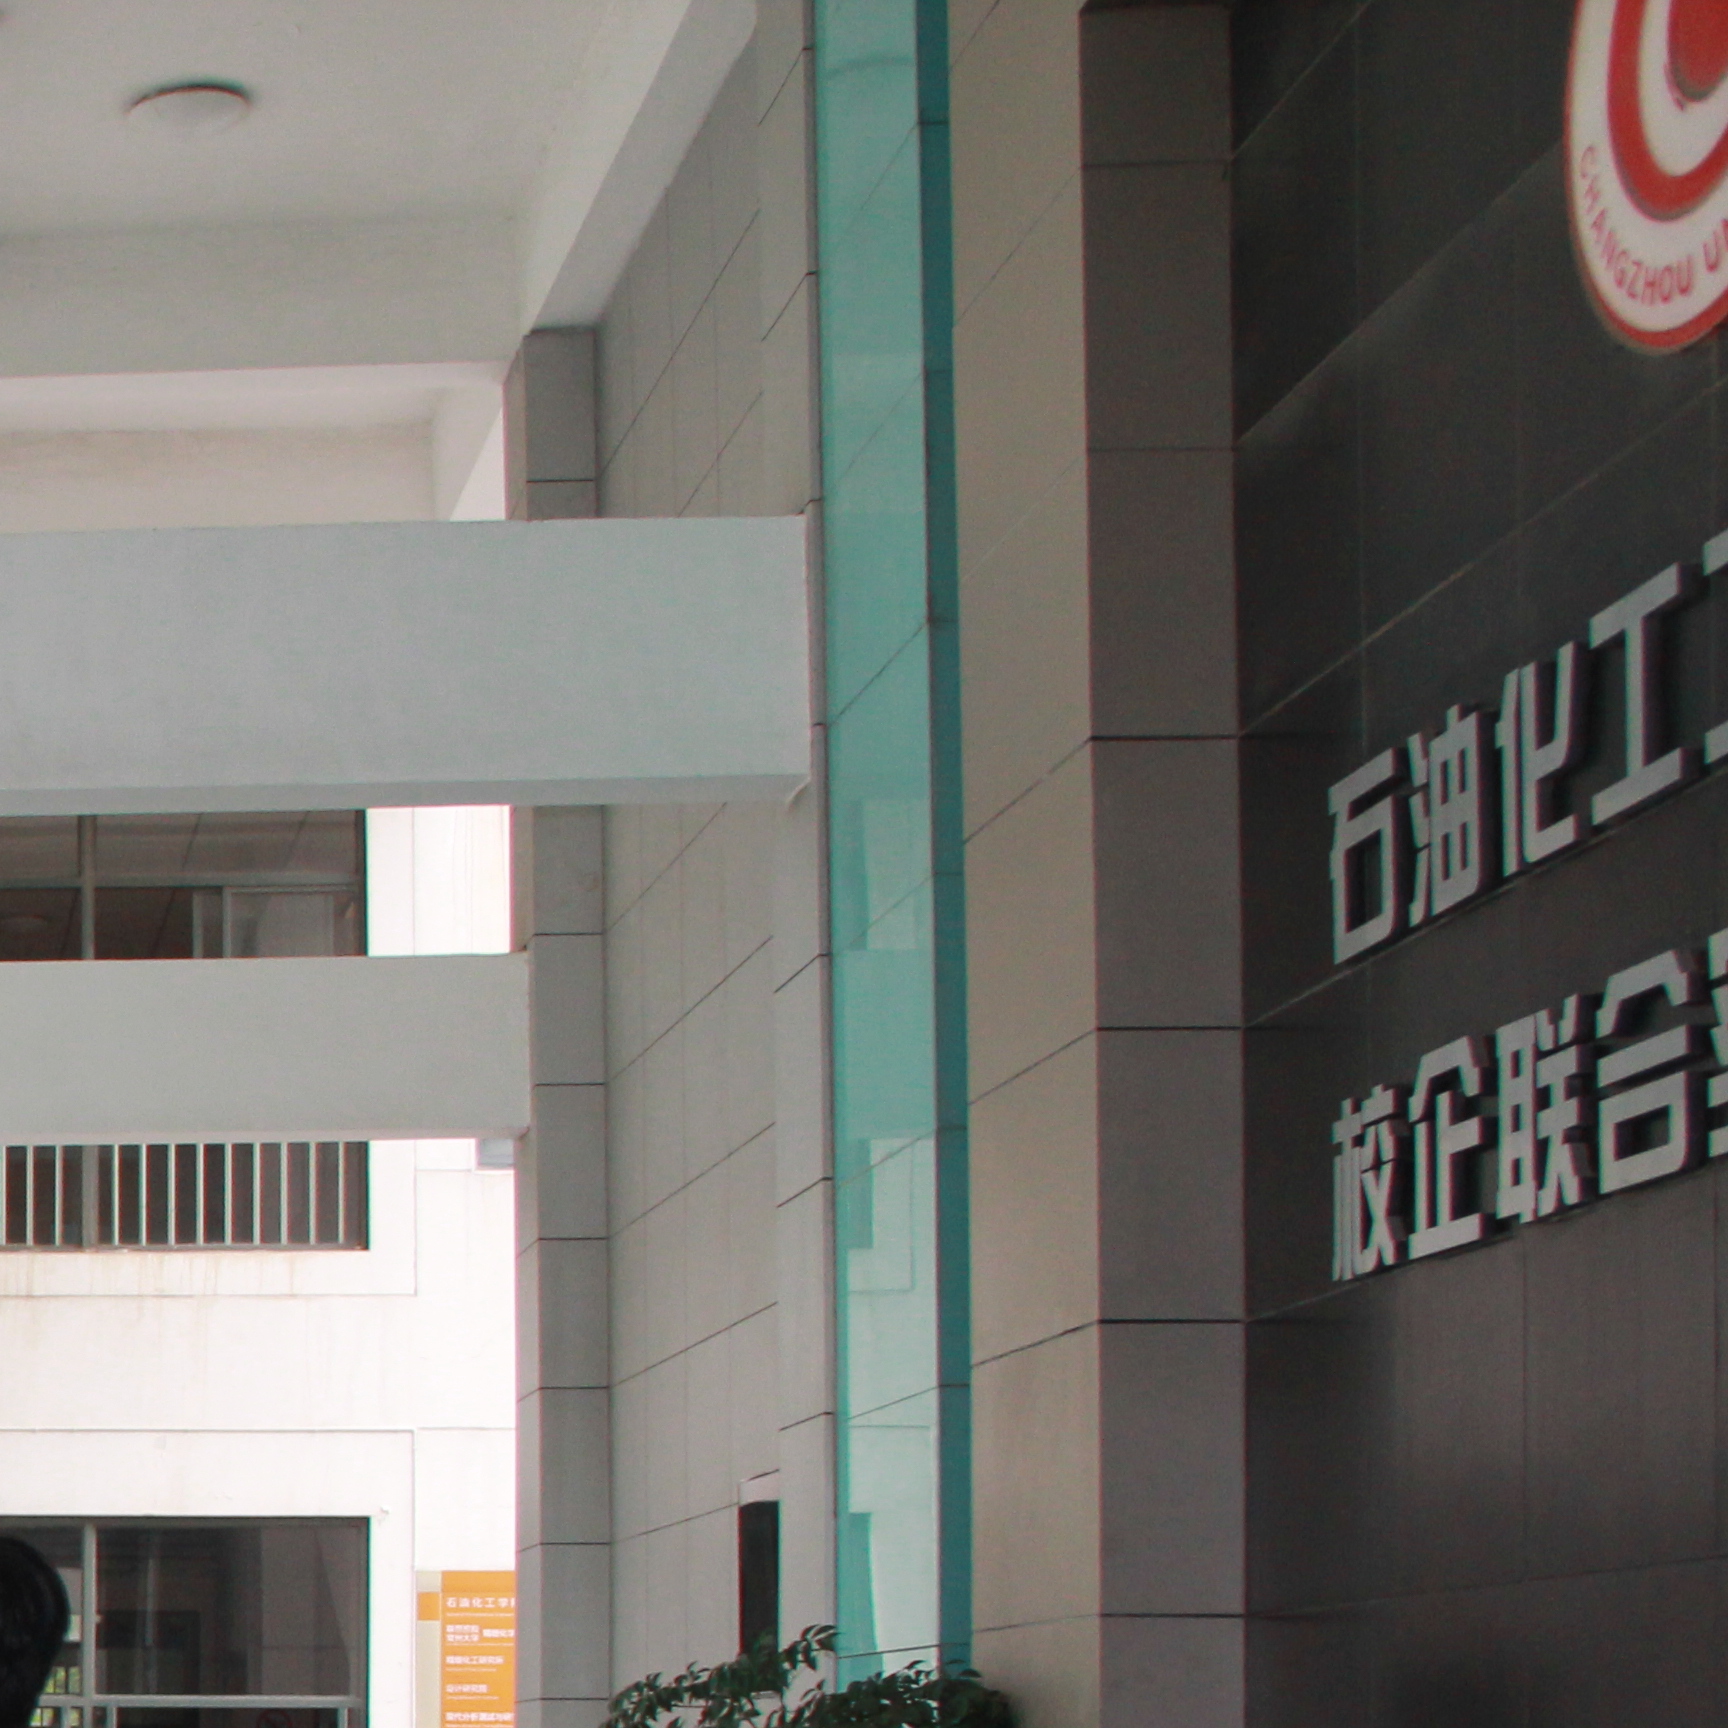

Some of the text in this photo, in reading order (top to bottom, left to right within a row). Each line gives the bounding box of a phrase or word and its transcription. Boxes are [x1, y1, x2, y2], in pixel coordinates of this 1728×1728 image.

[1579, 145, 1694, 306] CHANGZHOU
[1328, 527, 1728, 966] 石油化工
